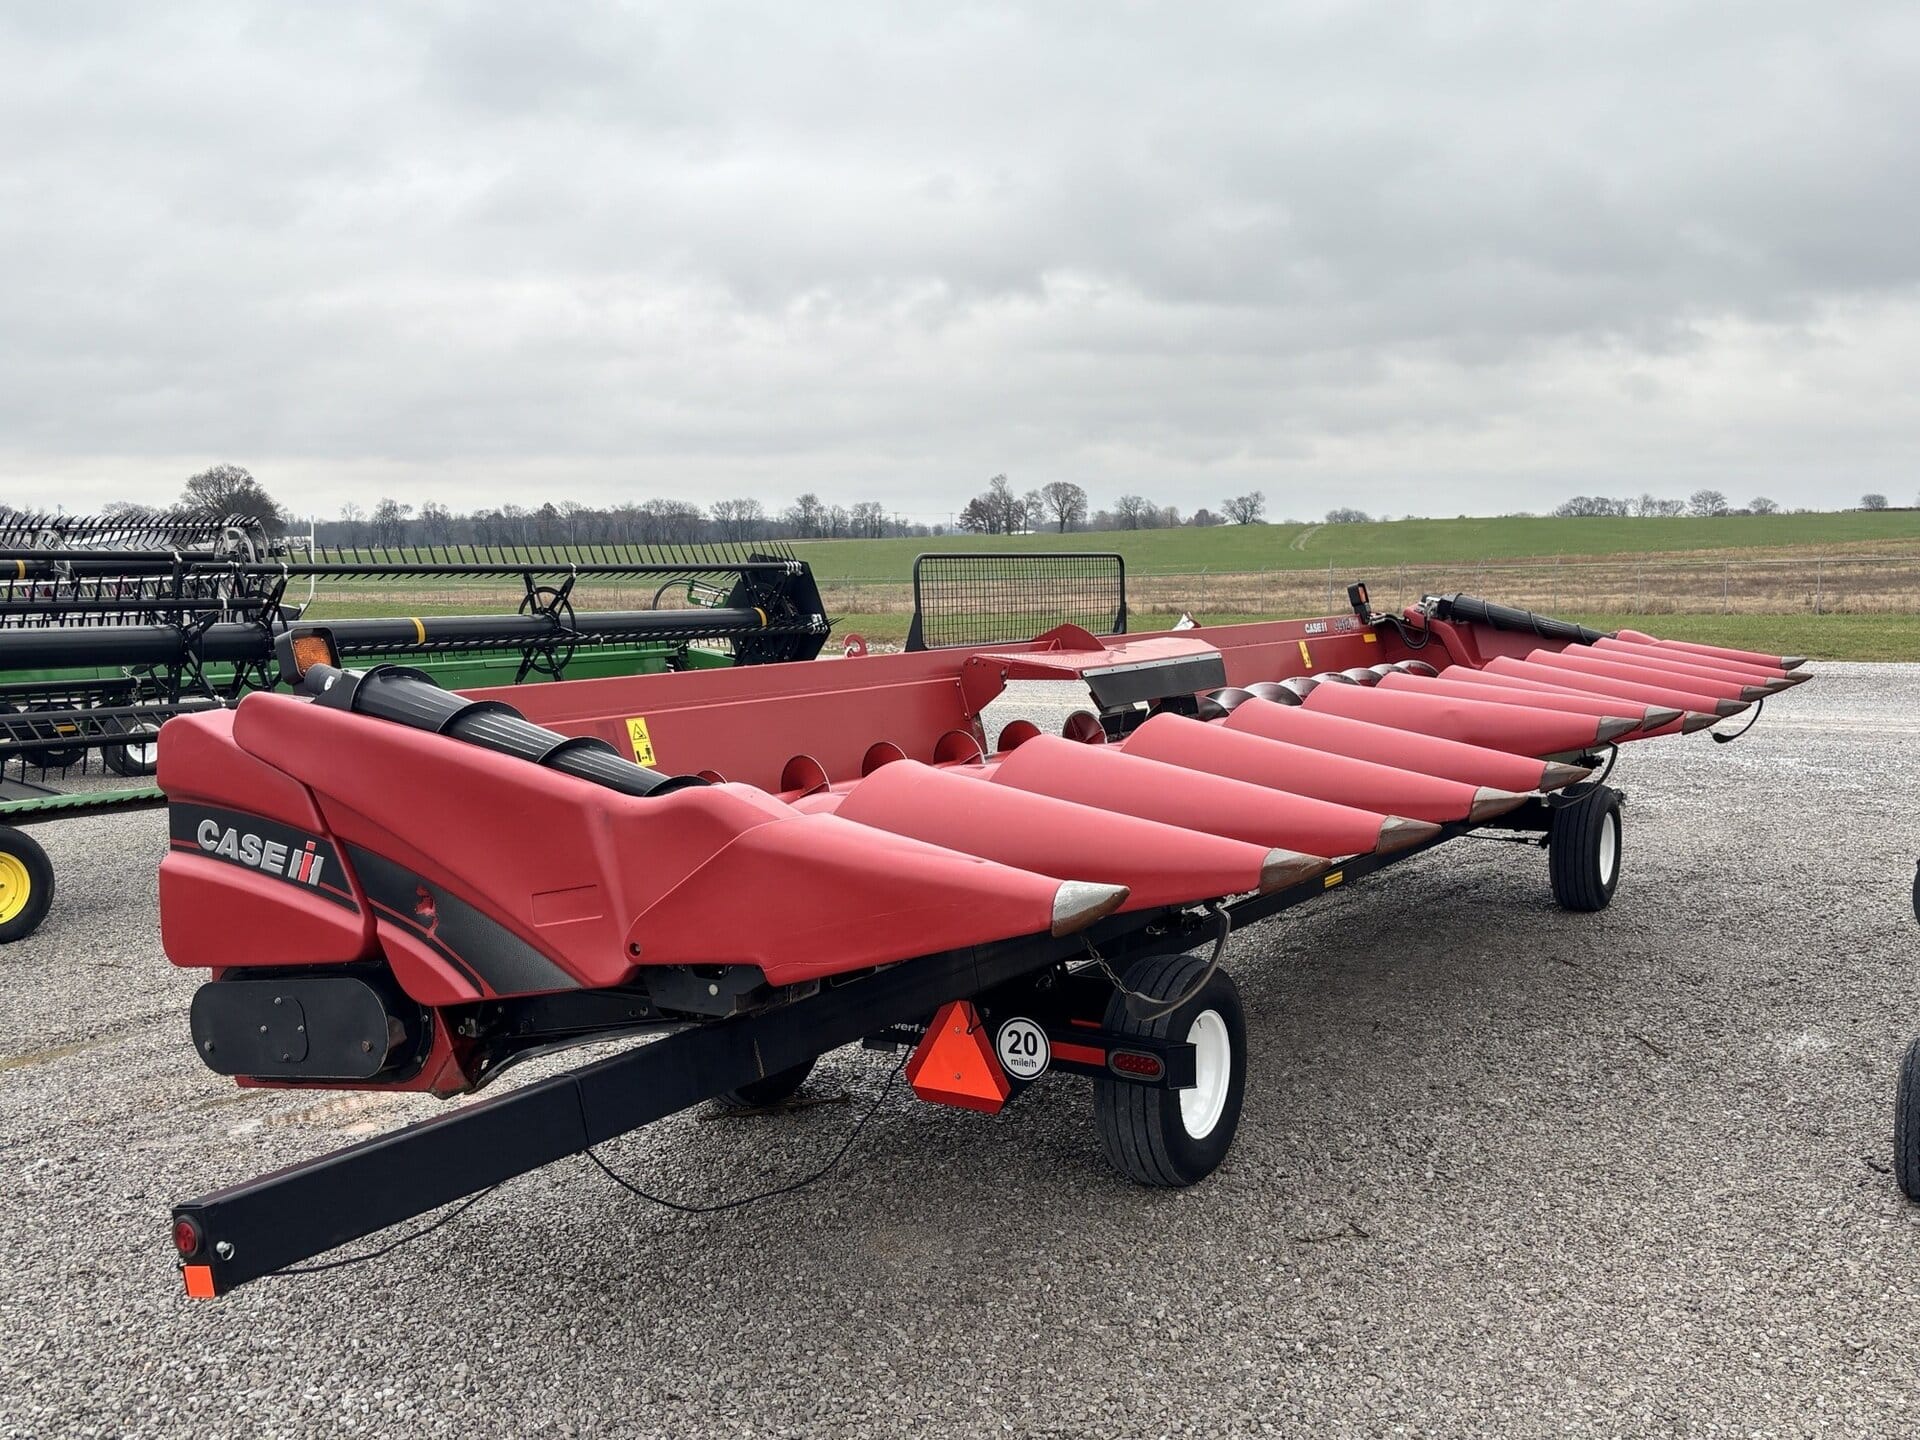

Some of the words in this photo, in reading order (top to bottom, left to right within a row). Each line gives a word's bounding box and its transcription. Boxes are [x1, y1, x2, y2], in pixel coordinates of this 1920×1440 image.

[1305, 622, 1321, 634] CASE
[197, 819, 288, 875] CASE
[1007, 1029, 1038, 1056] 20
[1010, 1058, 1037, 1069] mile/h
